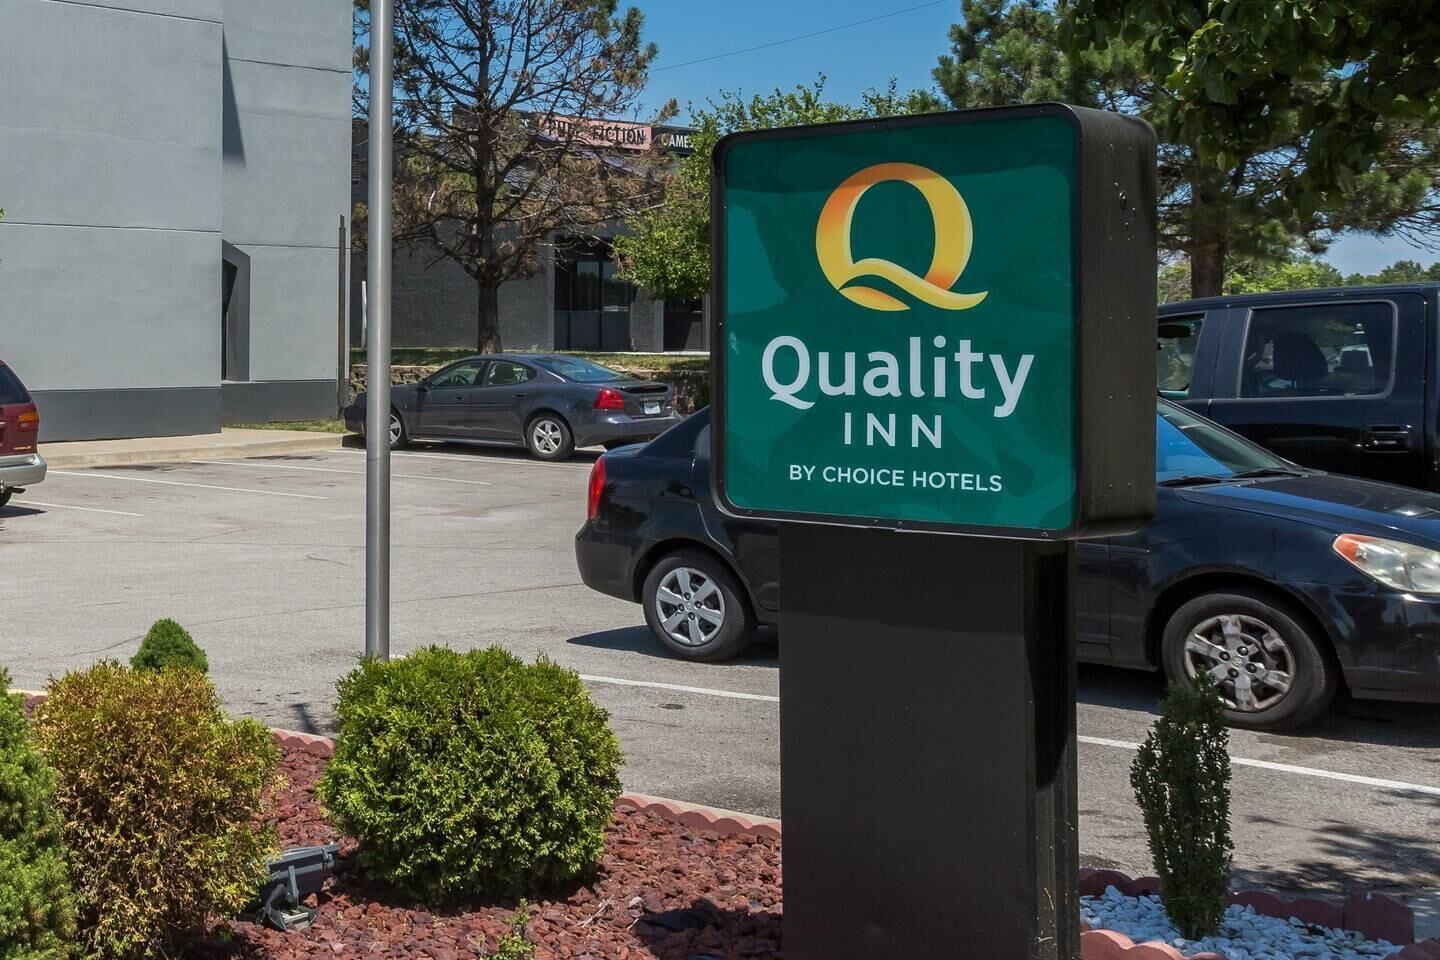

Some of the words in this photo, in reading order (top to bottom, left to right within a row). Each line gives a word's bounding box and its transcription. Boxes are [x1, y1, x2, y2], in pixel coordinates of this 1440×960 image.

[592, 125, 645, 145] FICTION
[816, 162, 989, 311] Q
[762, 335, 1034, 418] Quality
[844, 412, 942, 449] INN
[789, 464, 816, 481] BY
[822, 466, 905, 486] CHOICE
[912, 470, 1002, 492] HOTELS
